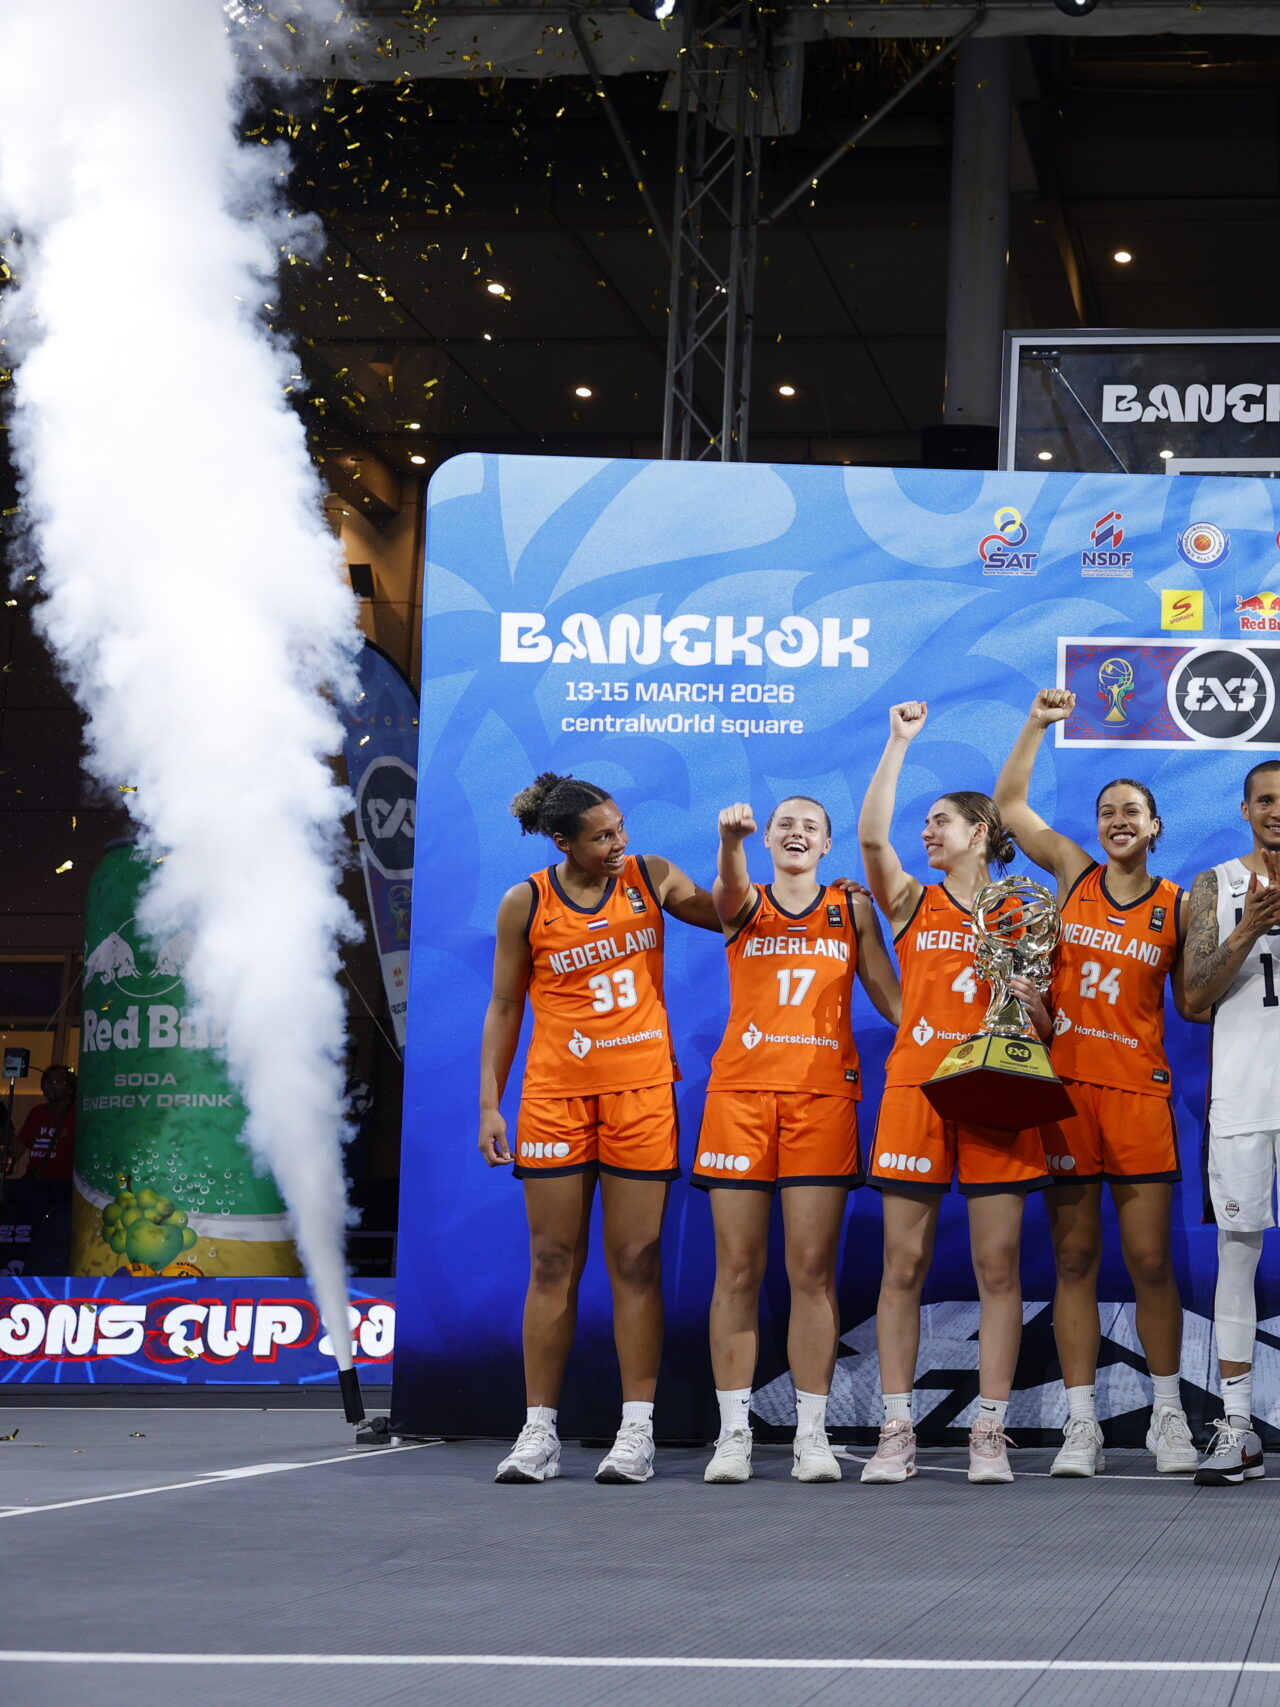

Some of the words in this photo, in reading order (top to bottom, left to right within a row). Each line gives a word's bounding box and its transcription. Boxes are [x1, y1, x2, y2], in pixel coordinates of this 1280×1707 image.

[984, 552, 1038, 569] SAT
[1083, 552, 1132, 567] NSDF
[1241, 617, 1266, 630] Red
[500, 611, 870, 668] BANGKOK
[565, 681, 629, 702] 13-15
[634, 682, 724, 703] MARCH
[730, 683, 795, 704] 2026
[1184, 677, 1259, 711] 3X3
[721, 718, 804, 738] square
[549, 927, 658, 975] NEDERLAND
[742, 936, 849, 962] NEDERLAND
[916, 930, 976, 952] NEDER
[1062, 922, 1162, 968] NEDERLAND
[587, 968, 638, 1013] 33
[776, 968, 817, 1006] 17
[951, 966, 978, 1004] 4
[1079, 960, 1122, 1005] 24
[83, 1005, 141, 1052] Red
[146, 1005, 228, 1048] Bul
[596, 1027, 662, 1050] Hartstichting
[1074, 1025, 1138, 1049] Hartstichting
[765, 1033, 839, 1050] Hartstichting
[114, 1072, 178, 1087] SODA
[82, 1094, 152, 1112] ENERGY
[156, 1093, 235, 1108] DRINK
[162, 1304, 302, 1357] CUP
